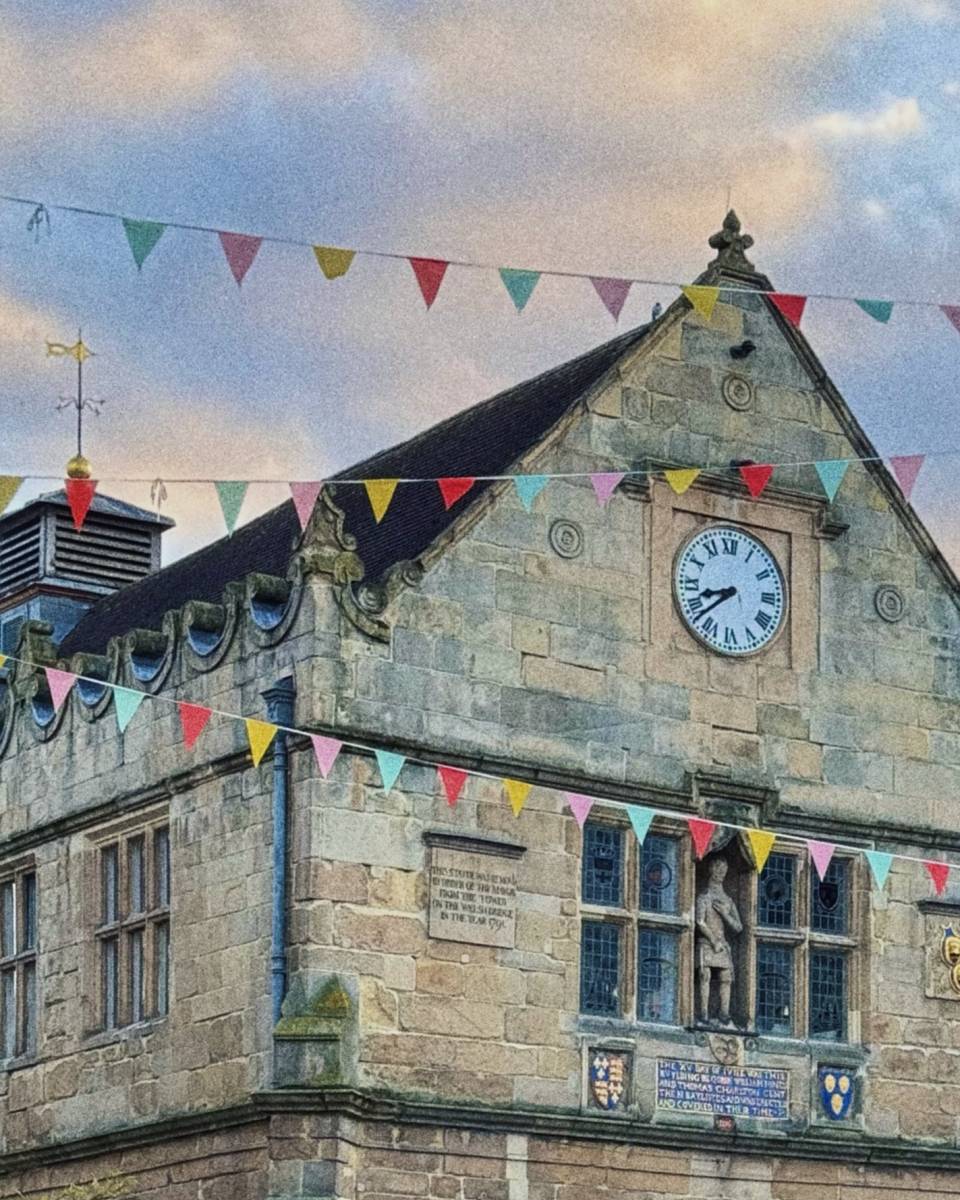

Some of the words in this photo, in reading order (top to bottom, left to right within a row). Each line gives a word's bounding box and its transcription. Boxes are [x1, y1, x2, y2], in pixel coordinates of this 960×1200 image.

[702, 538, 719, 560] XI
[722, 537, 739, 556] XII
[689, 554, 705, 572] X
[745, 549, 755, 563] I
[685, 575, 700, 592] IX
[755, 569, 770, 581] II
[761, 592, 776, 605] III
[744, 626, 757, 643] V
